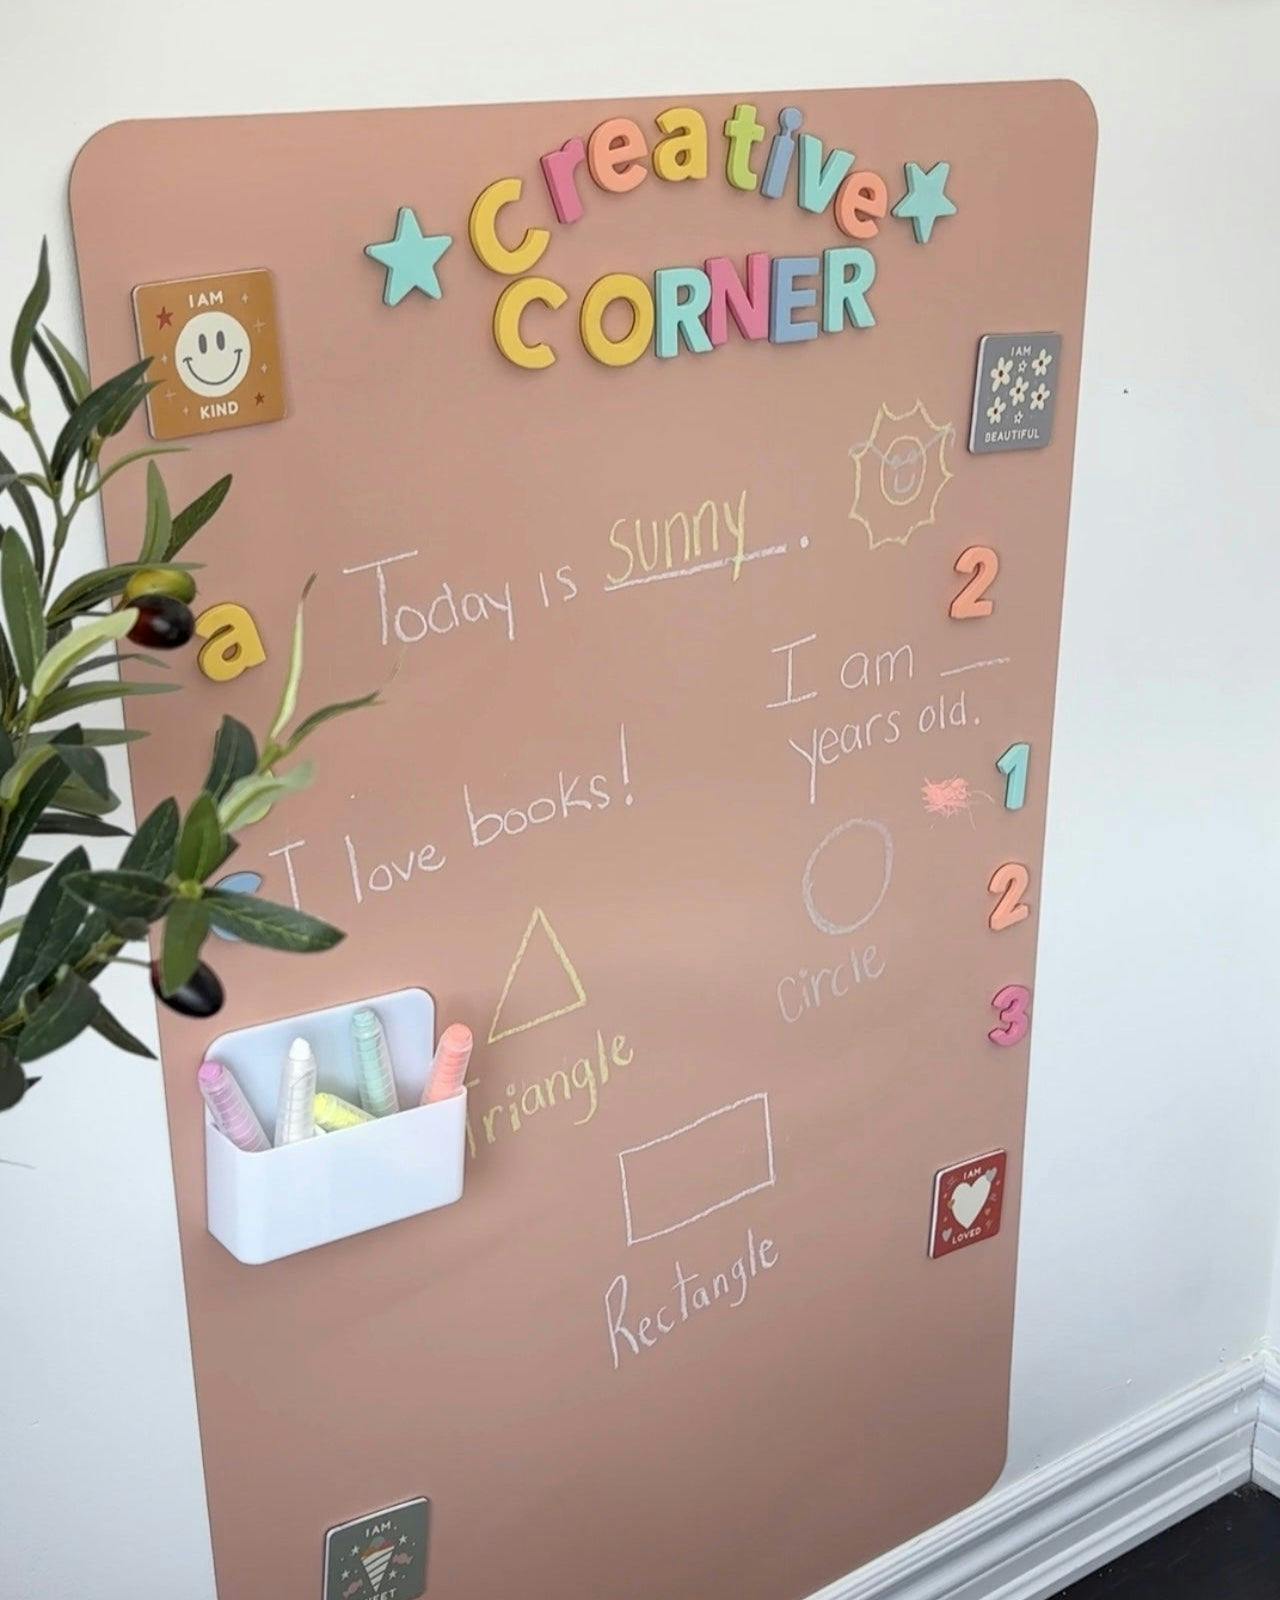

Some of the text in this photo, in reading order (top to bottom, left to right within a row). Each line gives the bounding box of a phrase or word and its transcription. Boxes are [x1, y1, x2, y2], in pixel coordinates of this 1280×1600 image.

[189, 290, 223, 308] I AM
[492, 246, 877, 369] CORNER
[1016, 345, 1032, 356] AM
[200, 401, 238, 419] KIND
[985, 429, 1040, 442] BEAUTIFUL
[343, 550, 515, 645] Today
[949, 545, 999, 619] 2
[194, 602, 266, 682] a
[766, 633, 914, 708] I am
[788, 690, 981, 804] years old.
[996, 742, 1030, 810] 1
[345, 835, 447, 903] love
[464, 722, 634, 848] books!
[988, 862, 1029, 930] 2
[777, 944, 886, 1023] Circle
[988, 984, 1030, 1047] 3
[967, 1166, 983, 1178] AM
[952, 1227, 982, 1244] LOVED
[605, 1228, 779, 1369] Rectangle
[365, 1520, 392, 1538] I AM
